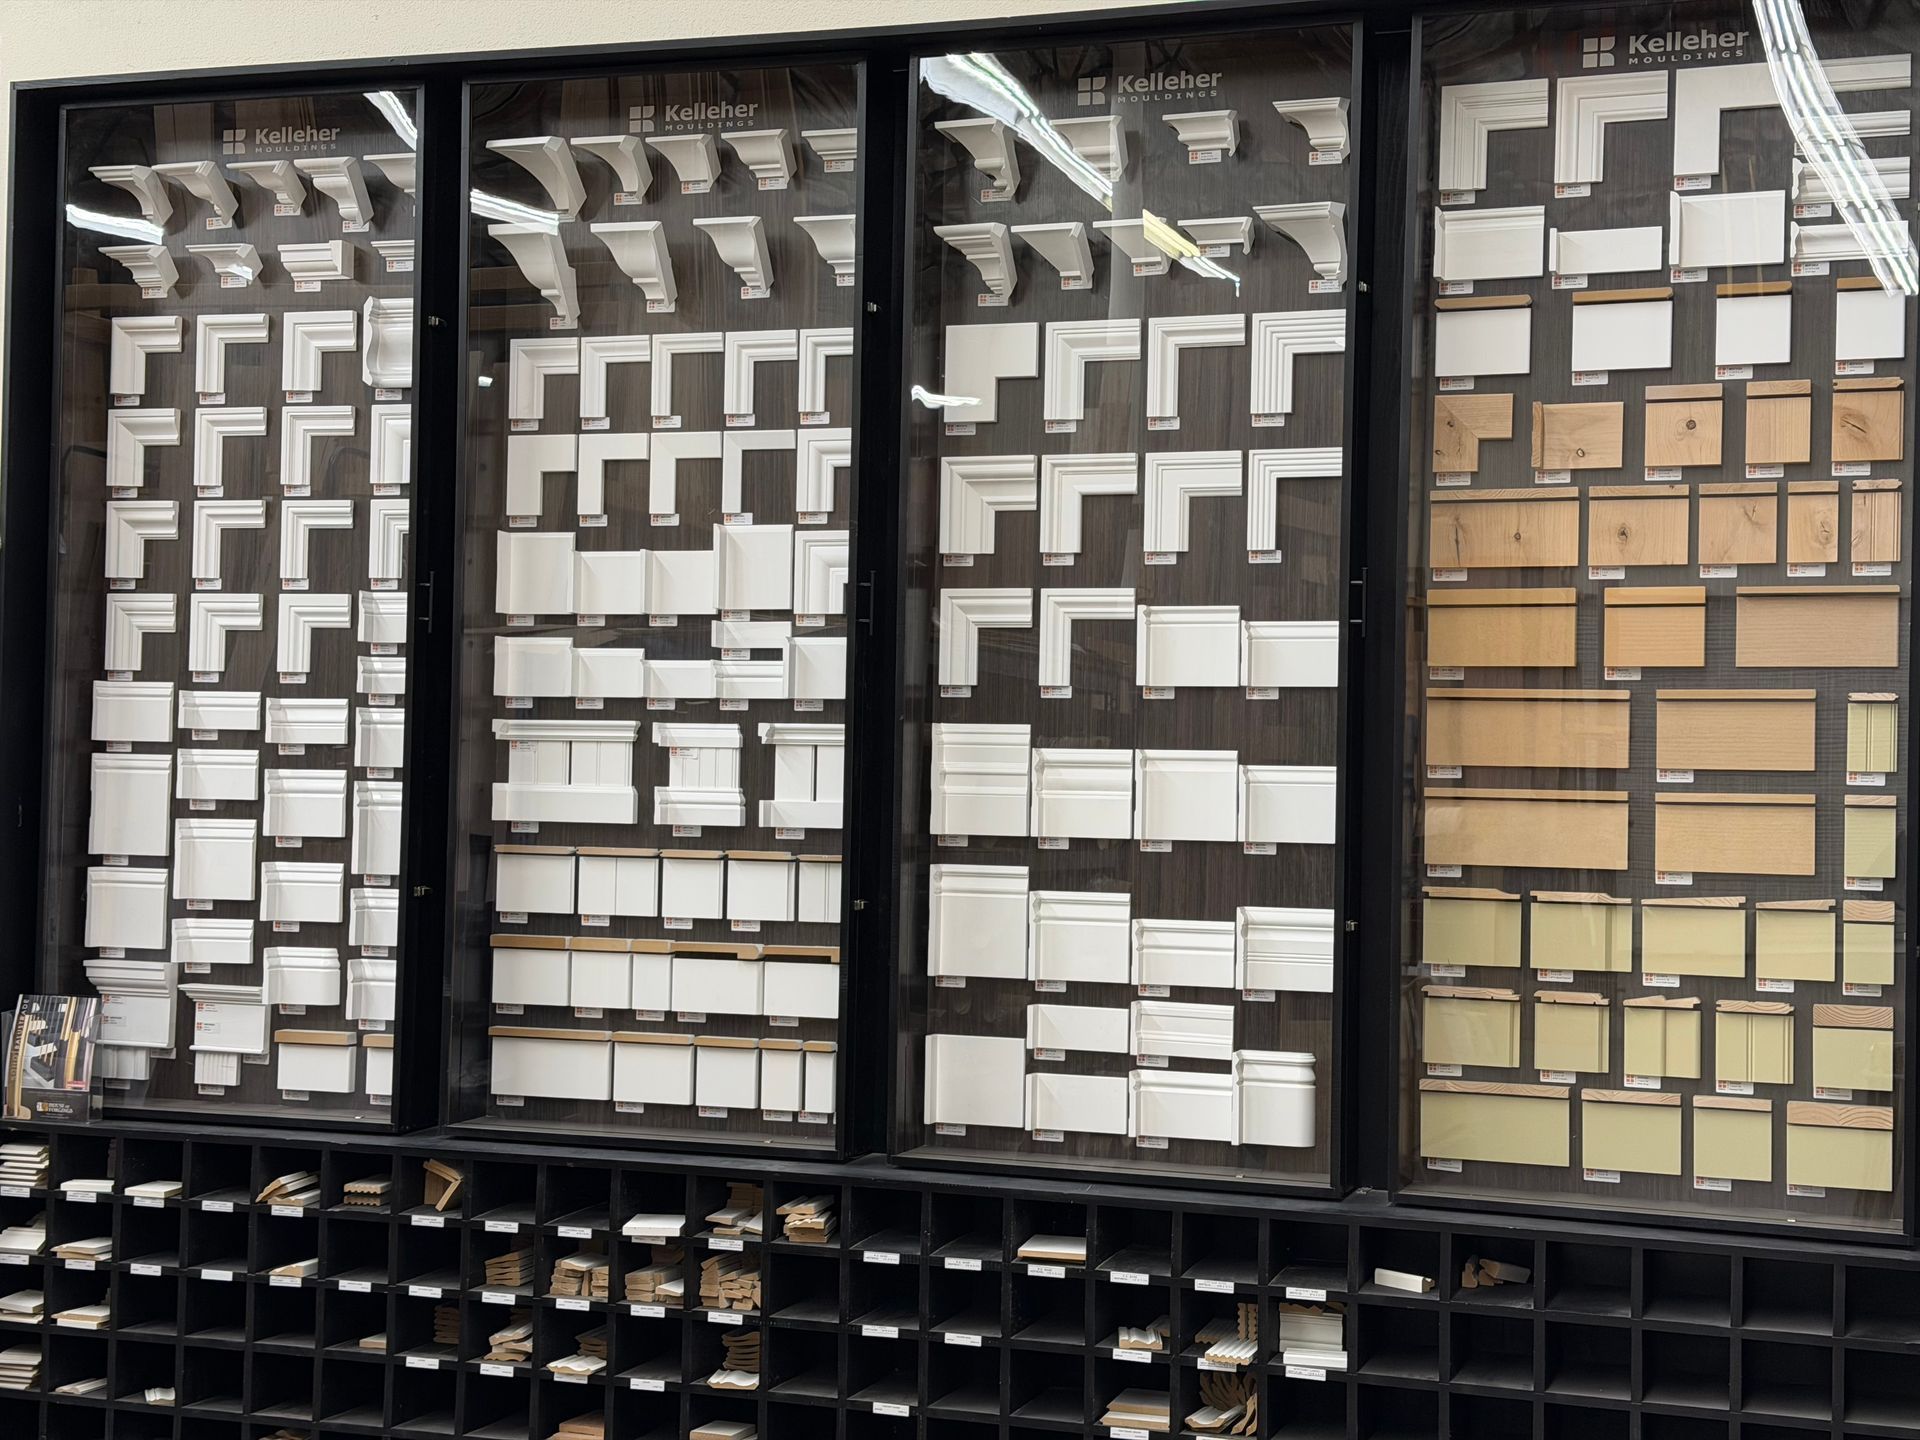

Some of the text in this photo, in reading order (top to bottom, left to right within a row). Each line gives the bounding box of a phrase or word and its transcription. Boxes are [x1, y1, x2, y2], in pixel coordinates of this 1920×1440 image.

[1629, 29, 1749, 54] Kelleher
[1628, 50, 1744, 65] MOULDINGS
[1118, 70, 1222, 93] Kelleher
[1117, 90, 1217, 103] MOULDINGS
[665, 101, 759, 122] Kelleher
[665, 120, 754, 131] MOULDINGS
[255, 125, 340, 144] Kelleher
[255, 143, 336, 153] MOULDINGS
